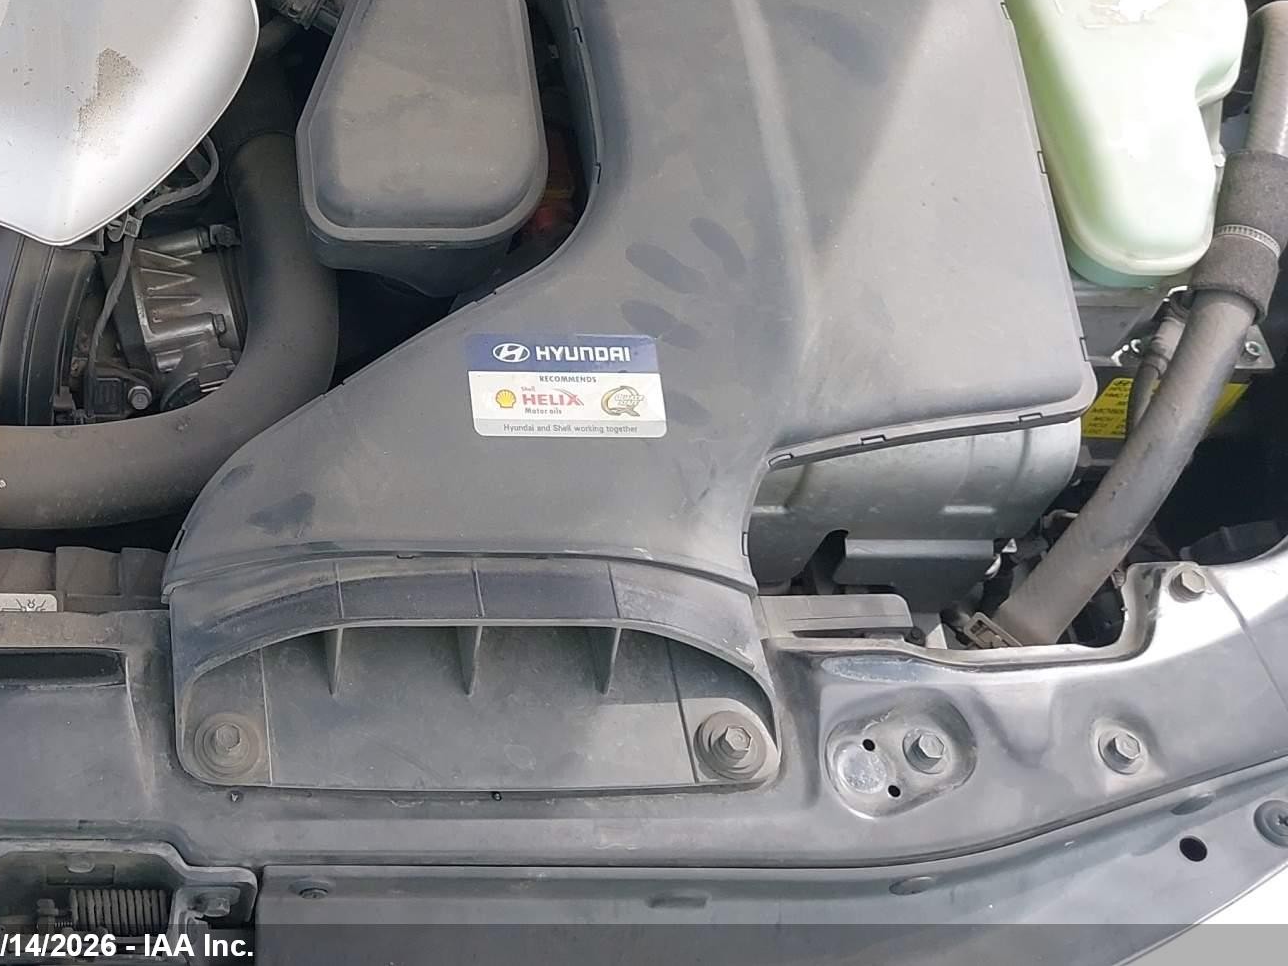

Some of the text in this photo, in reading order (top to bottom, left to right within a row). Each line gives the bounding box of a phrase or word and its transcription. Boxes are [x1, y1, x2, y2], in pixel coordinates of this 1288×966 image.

[535, 346, 631, 362] HYUNDAI
[539, 375, 597, 383] RECOMMENDS
[522, 393, 583, 406] HELIX
[524, 407, 562, 415] Motor oils
[503, 423, 638, 434] Hyundai and Shell working together
